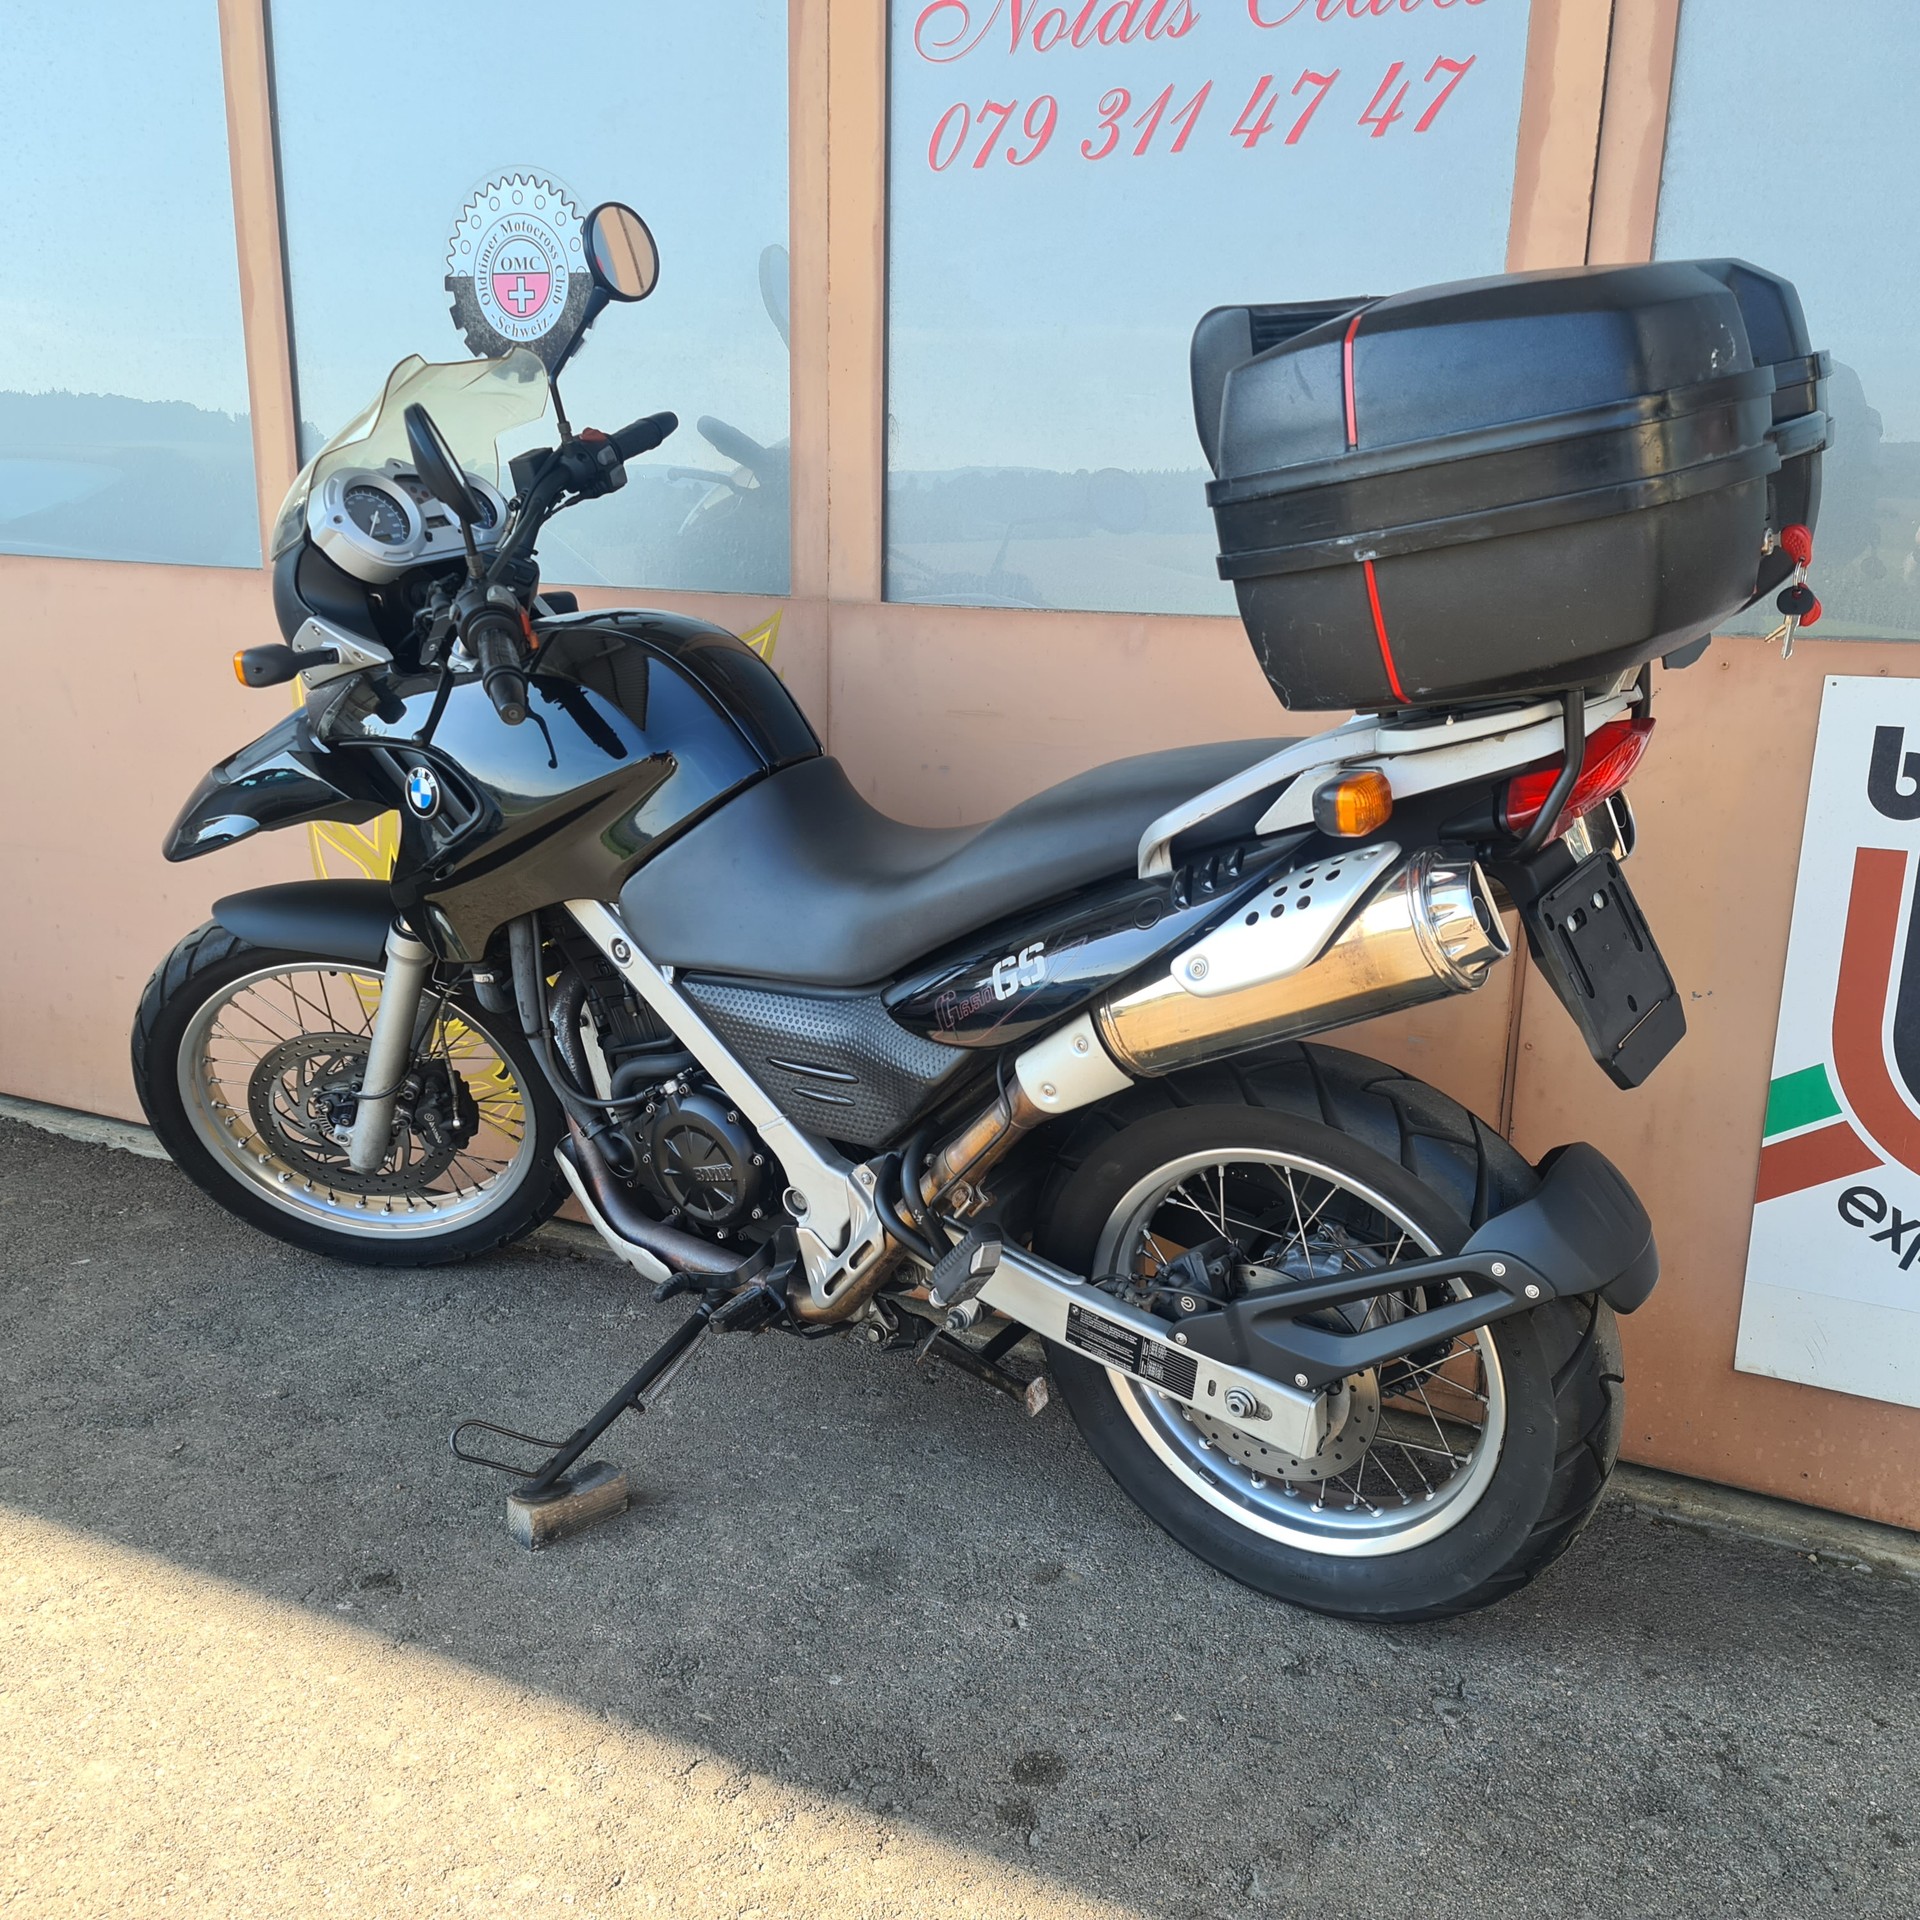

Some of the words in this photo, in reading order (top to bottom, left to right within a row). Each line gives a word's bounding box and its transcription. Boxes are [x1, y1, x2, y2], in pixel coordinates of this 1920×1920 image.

[928, 94, 1058, 172] 079
[1081, 77, 1213, 161] 311
[1230, 68, 1341, 148] 47
[1357, 54, 1476, 138] 47
[477, 234, 498, 306] Oldtimer
[500, 219, 559, 260] Motocross
[552, 264, 566, 305] Club
[500, 256, 541, 272] OMC
[992, 941, 1046, 1001] GS
[694, 1166, 733, 1182] BMW
